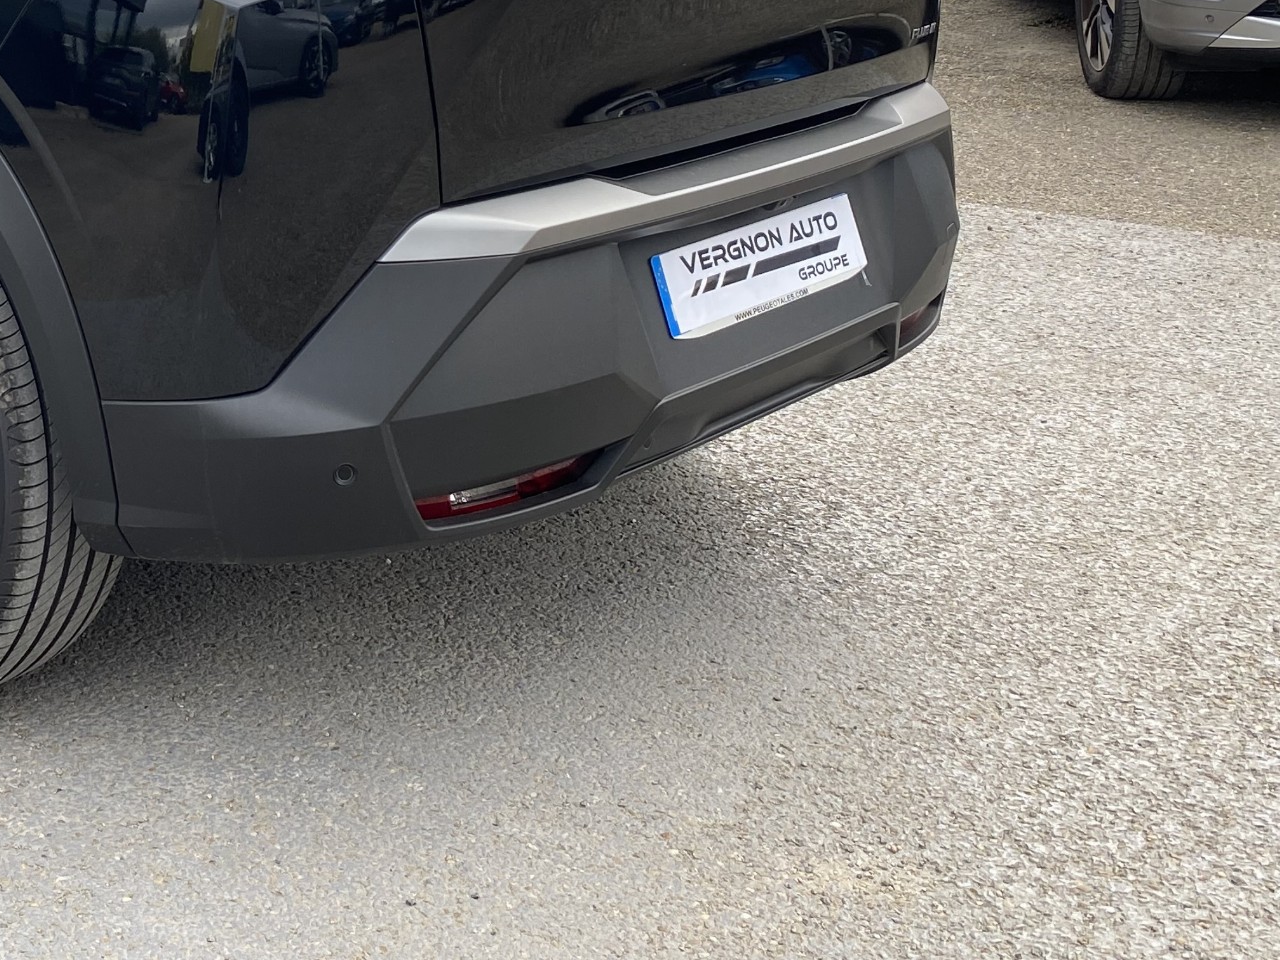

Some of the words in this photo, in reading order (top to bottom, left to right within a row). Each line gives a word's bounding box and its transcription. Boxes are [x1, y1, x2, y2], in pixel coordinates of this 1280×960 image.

[679, 226, 782, 274] VERGNON
[789, 211, 838, 244] AUTO
[798, 253, 850, 281] GROUPE
